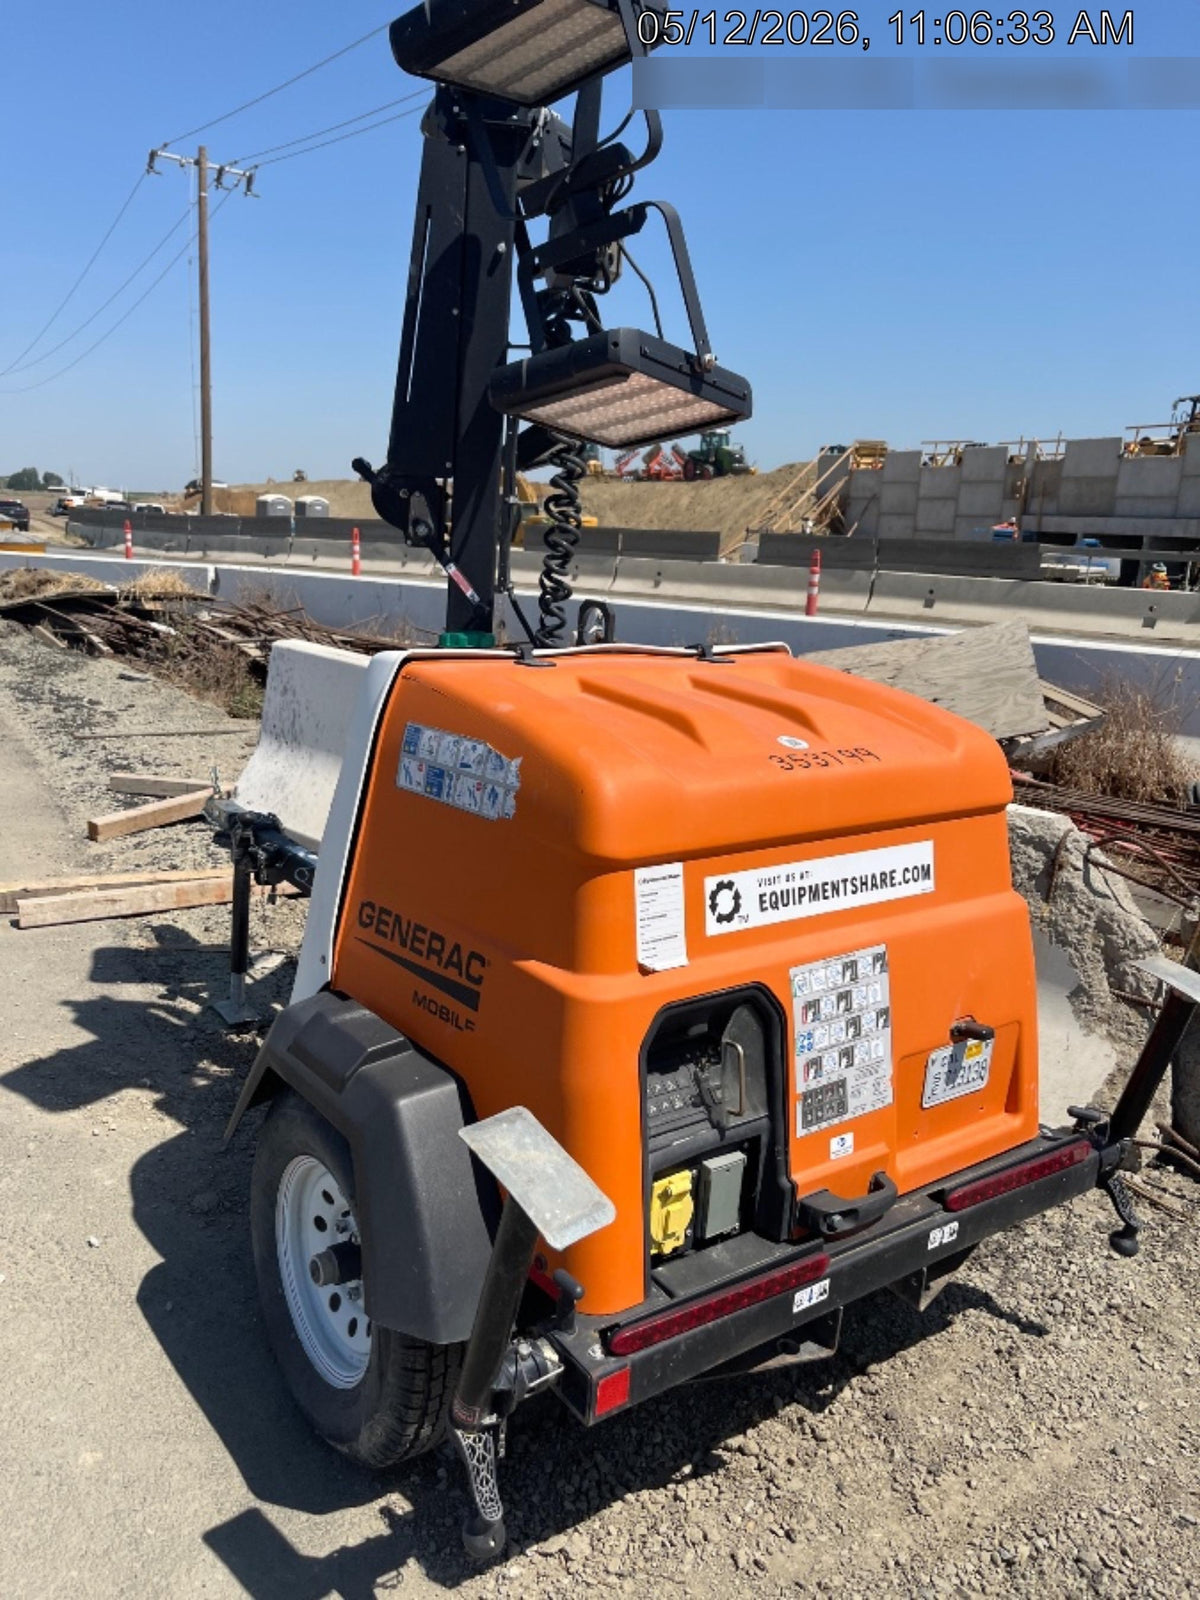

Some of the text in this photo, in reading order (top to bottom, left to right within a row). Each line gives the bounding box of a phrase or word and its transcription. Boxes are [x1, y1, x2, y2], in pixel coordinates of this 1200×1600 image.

[757, 874, 781, 888] VISIT
[785, 872, 796, 883] US
[758, 863, 931, 912] EQUIPMENTSHARE.COM
[358, 900, 486, 986] GENERAC
